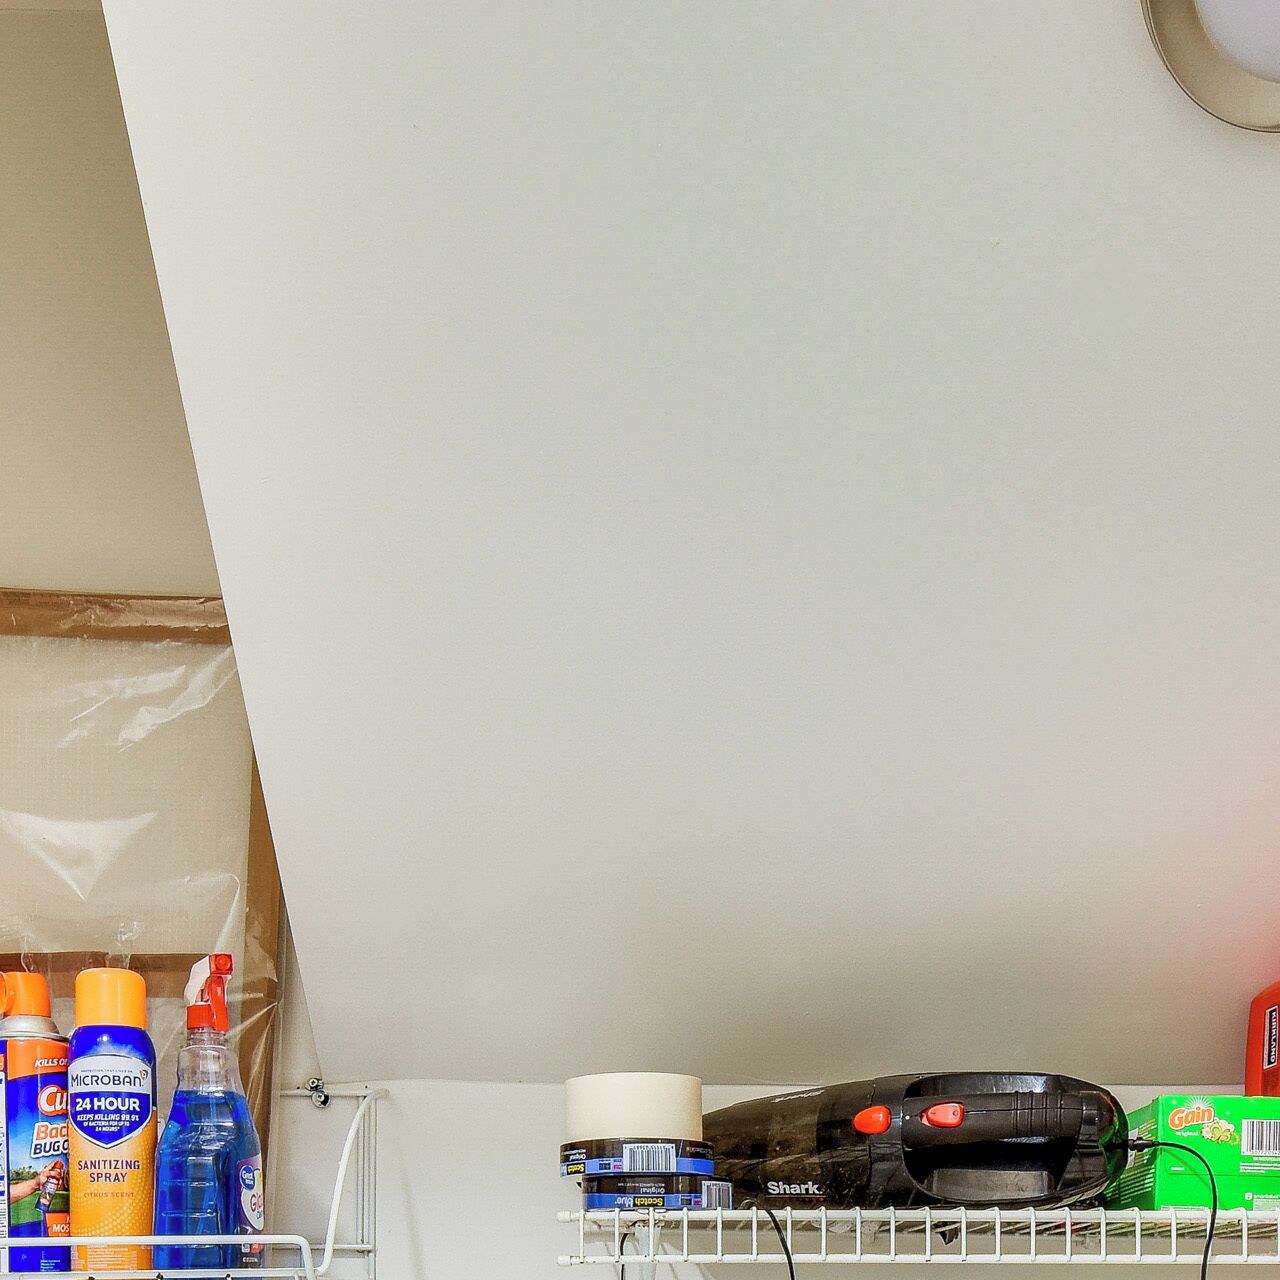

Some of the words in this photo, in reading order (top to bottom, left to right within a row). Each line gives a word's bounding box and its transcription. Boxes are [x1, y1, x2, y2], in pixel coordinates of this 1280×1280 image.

[35, 1058, 57, 1067] KILLS
[76, 1098, 91, 1111] 24
[93, 1097, 140, 1111] HOUR
[95, 1113, 120, 1121] KILLING
[1169, 1106, 1214, 1129] Gain
[33, 1141, 61, 1155] BUG
[78, 1160, 140, 1170] SANITIZING
[89, 1172, 127, 1182] SPRAY
[640, 1186, 666, 1194] Original
[767, 1181, 820, 1194] Shark
[634, 1198, 664, 1206] Scotch
